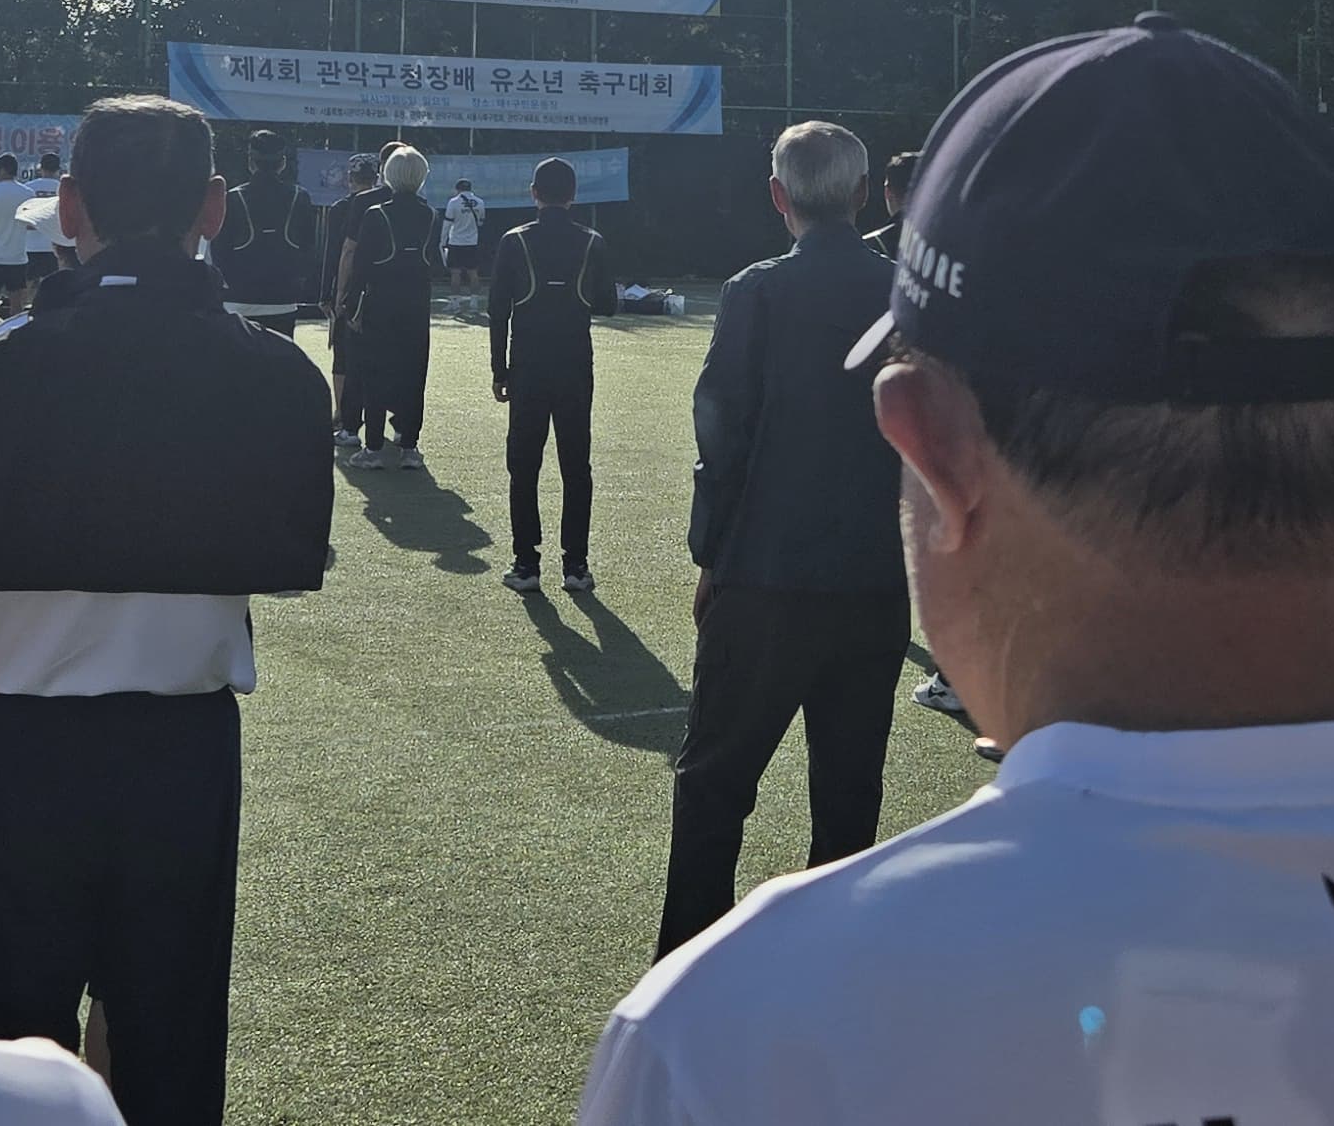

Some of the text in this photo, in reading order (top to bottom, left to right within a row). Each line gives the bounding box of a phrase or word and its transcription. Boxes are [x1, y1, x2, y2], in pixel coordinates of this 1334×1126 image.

[230, 56, 673, 97] 제4회 관악구청장배 유소년 축구대회
[10, 128, 61, 155] 이용
